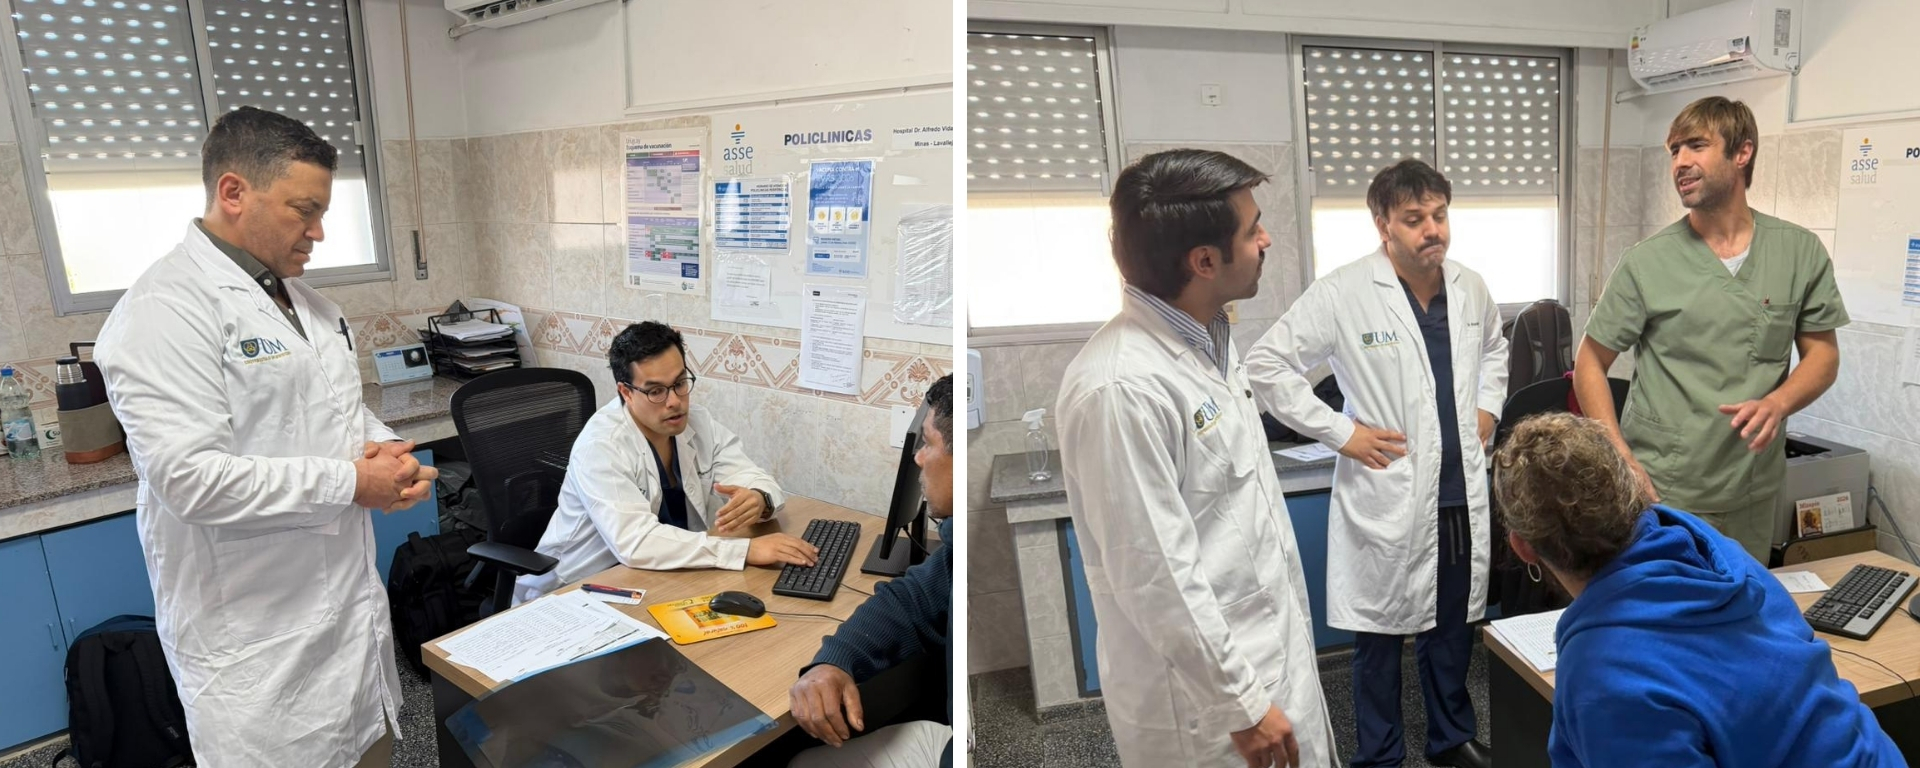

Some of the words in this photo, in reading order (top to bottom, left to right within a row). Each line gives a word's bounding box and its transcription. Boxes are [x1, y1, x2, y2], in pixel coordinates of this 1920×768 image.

[784, 129, 872, 146] POLICLINICAS
[723, 146, 753, 160] asse
[724, 160, 753, 175] salud
[1851, 158, 1879, 171] asse
[1850, 171, 1877, 184] salud
